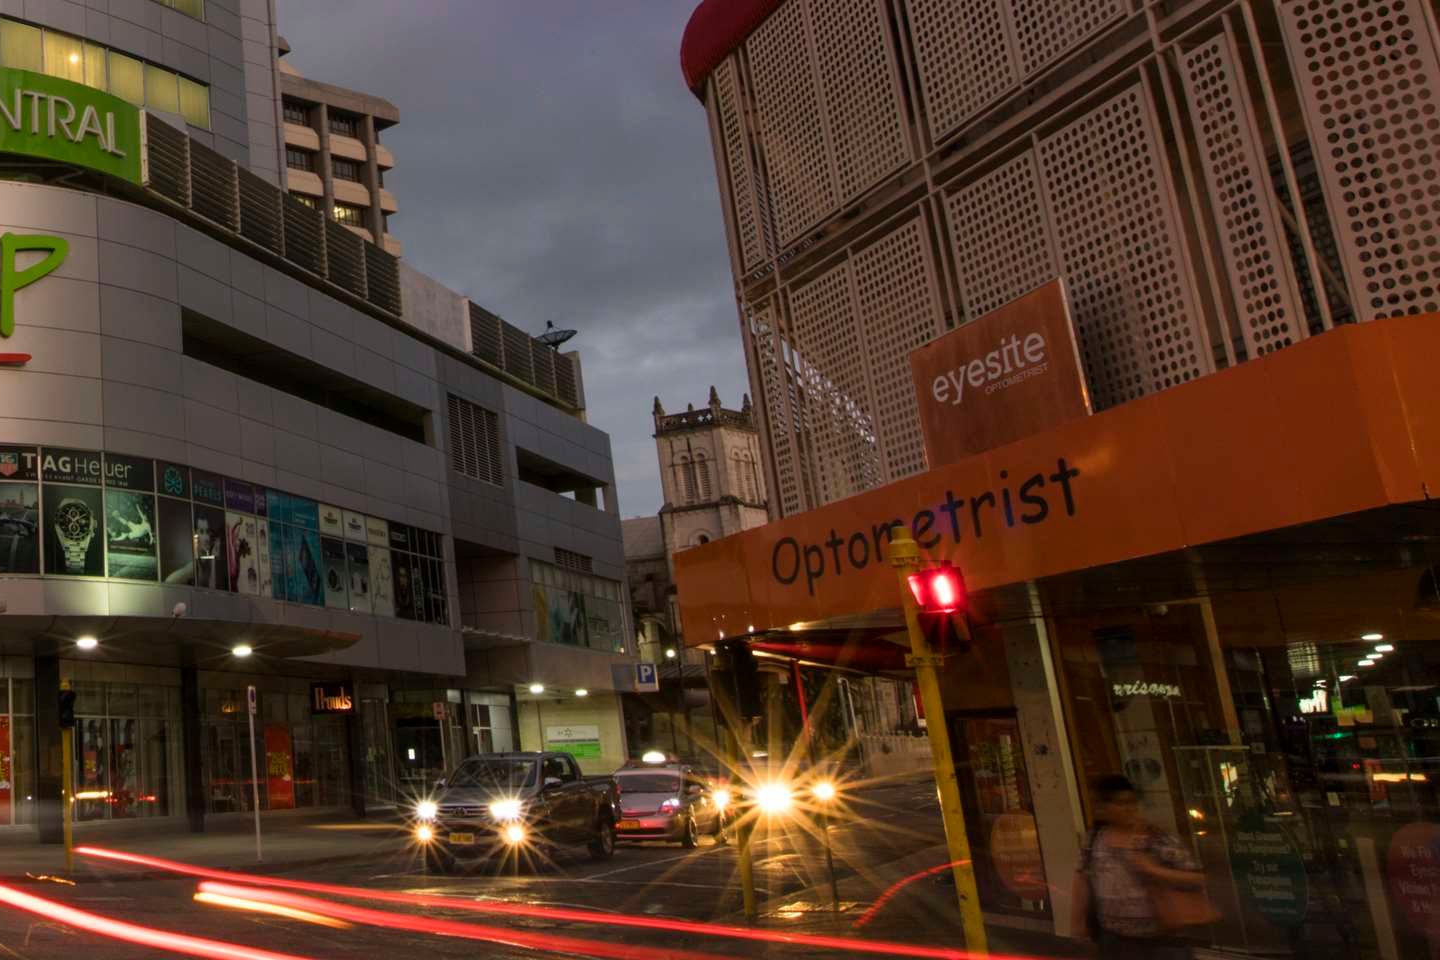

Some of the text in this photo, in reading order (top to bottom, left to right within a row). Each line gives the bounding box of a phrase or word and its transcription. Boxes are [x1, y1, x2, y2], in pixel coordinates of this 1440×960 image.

[932, 331, 1047, 406] eyesite
[984, 361, 1049, 395] OPTOMETRIST
[21, 452, 71, 473] TAG
[74, 457, 133, 480] Heuer
[640, 665, 651, 682] P
[314, 686, 352, 711] Prouds
